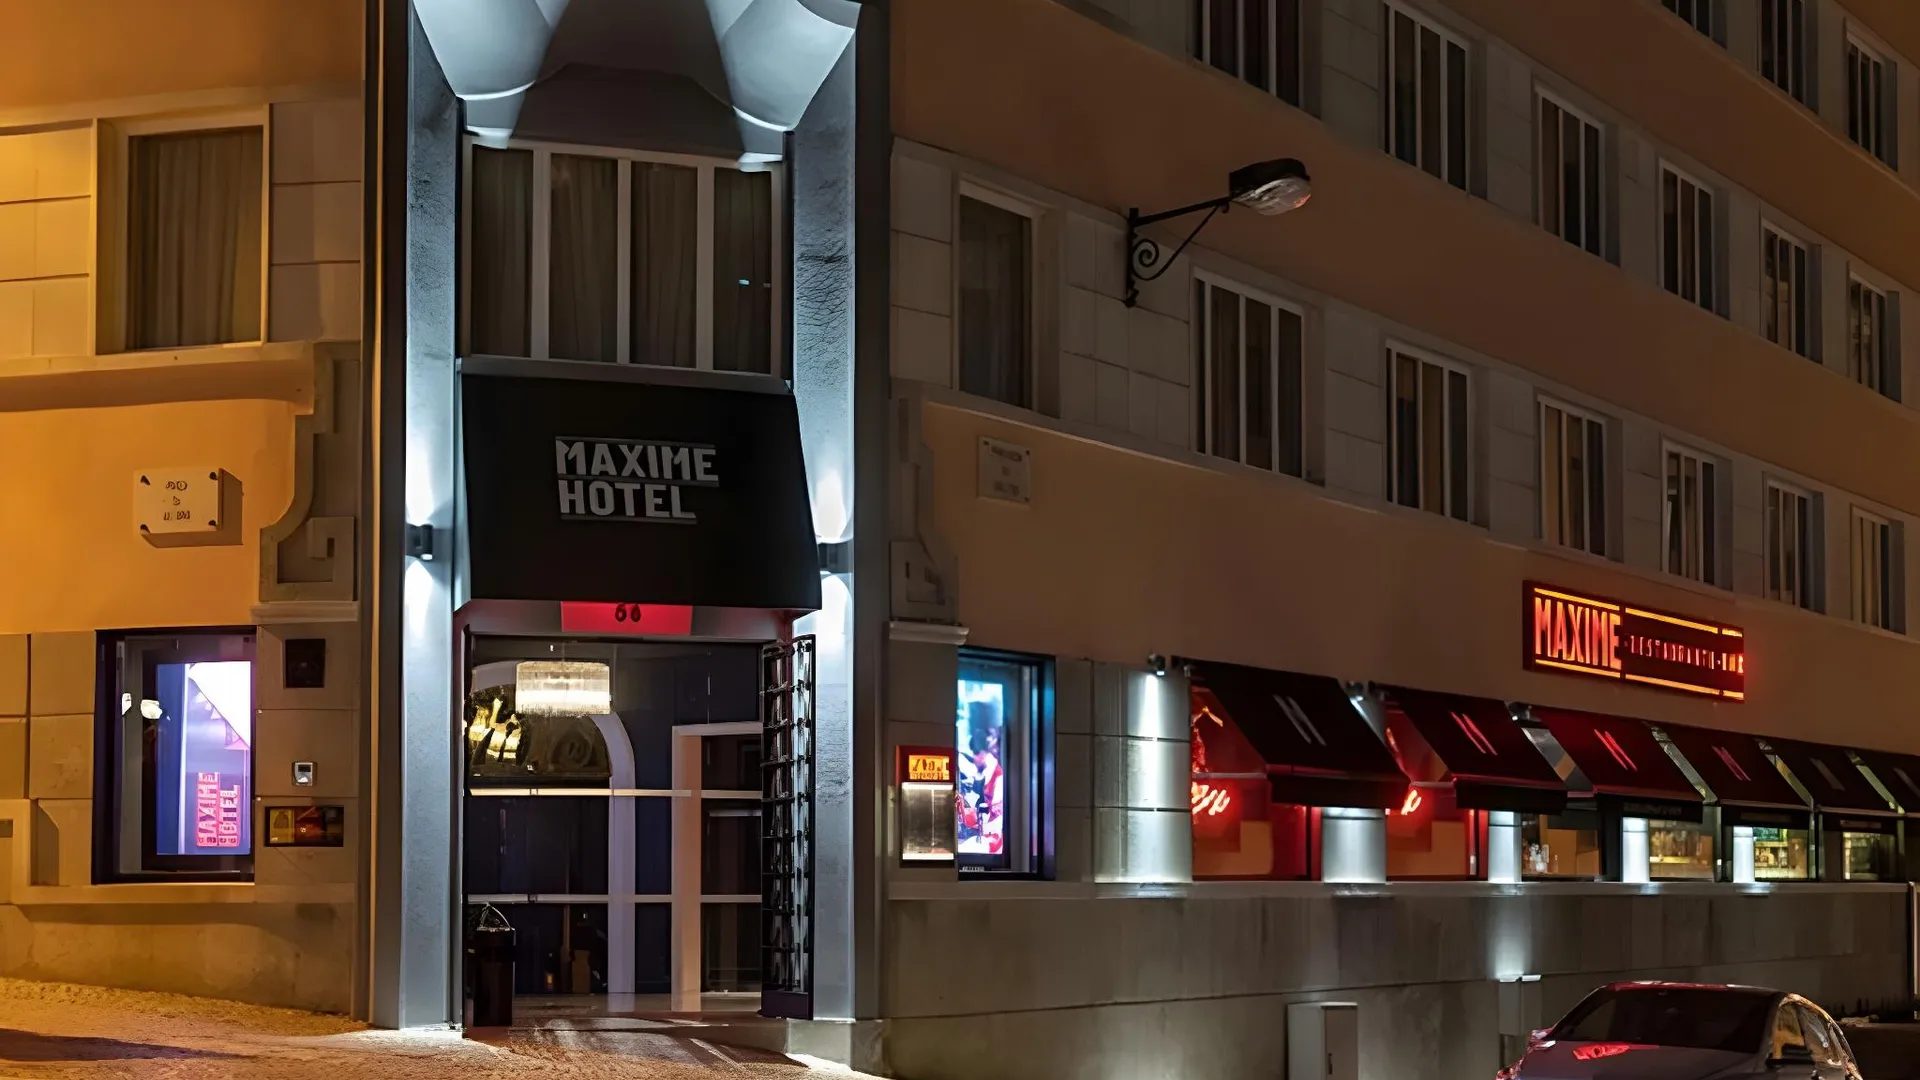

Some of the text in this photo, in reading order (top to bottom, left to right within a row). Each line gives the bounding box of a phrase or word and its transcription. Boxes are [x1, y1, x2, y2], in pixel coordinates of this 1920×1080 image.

[556, 440, 719, 481] MAXIME
[558, 480, 697, 519] HOTEL
[1534, 596, 1622, 670] MAXIME
